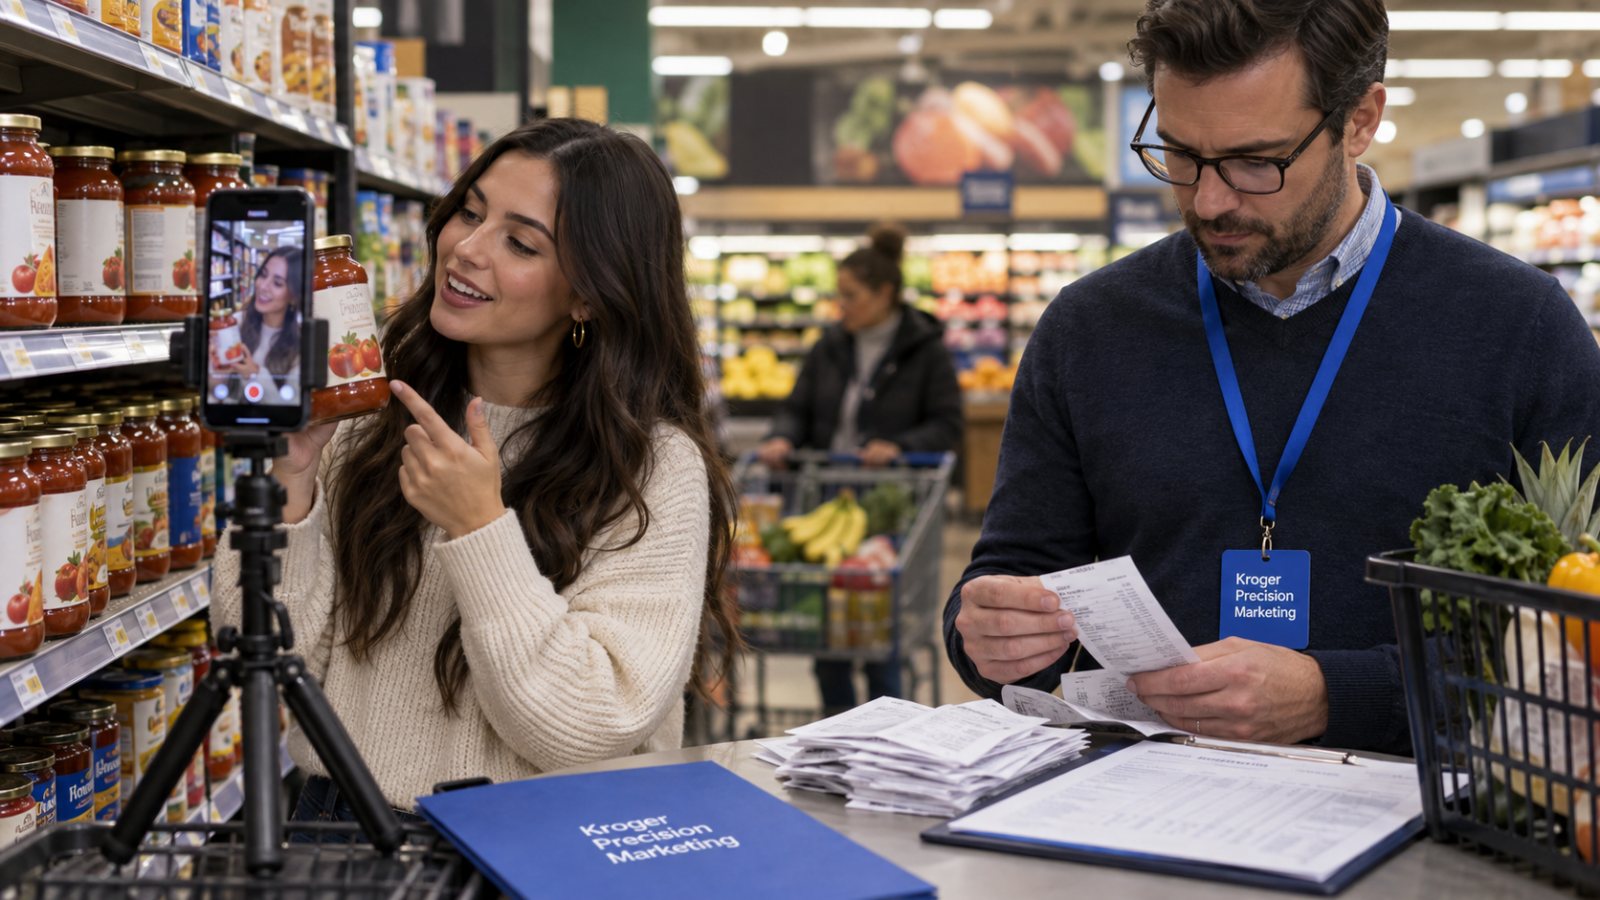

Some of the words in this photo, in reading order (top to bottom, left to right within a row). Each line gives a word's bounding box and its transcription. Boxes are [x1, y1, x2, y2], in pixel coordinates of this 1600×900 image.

[1236, 573, 1281, 588] Kroger
[1235, 589, 1294, 601] Precision
[1234, 606, 1297, 621] Marketing
[579, 815, 668, 837] Kroger
[592, 823, 713, 850] Precision
[606, 835, 740, 865] Marketing
